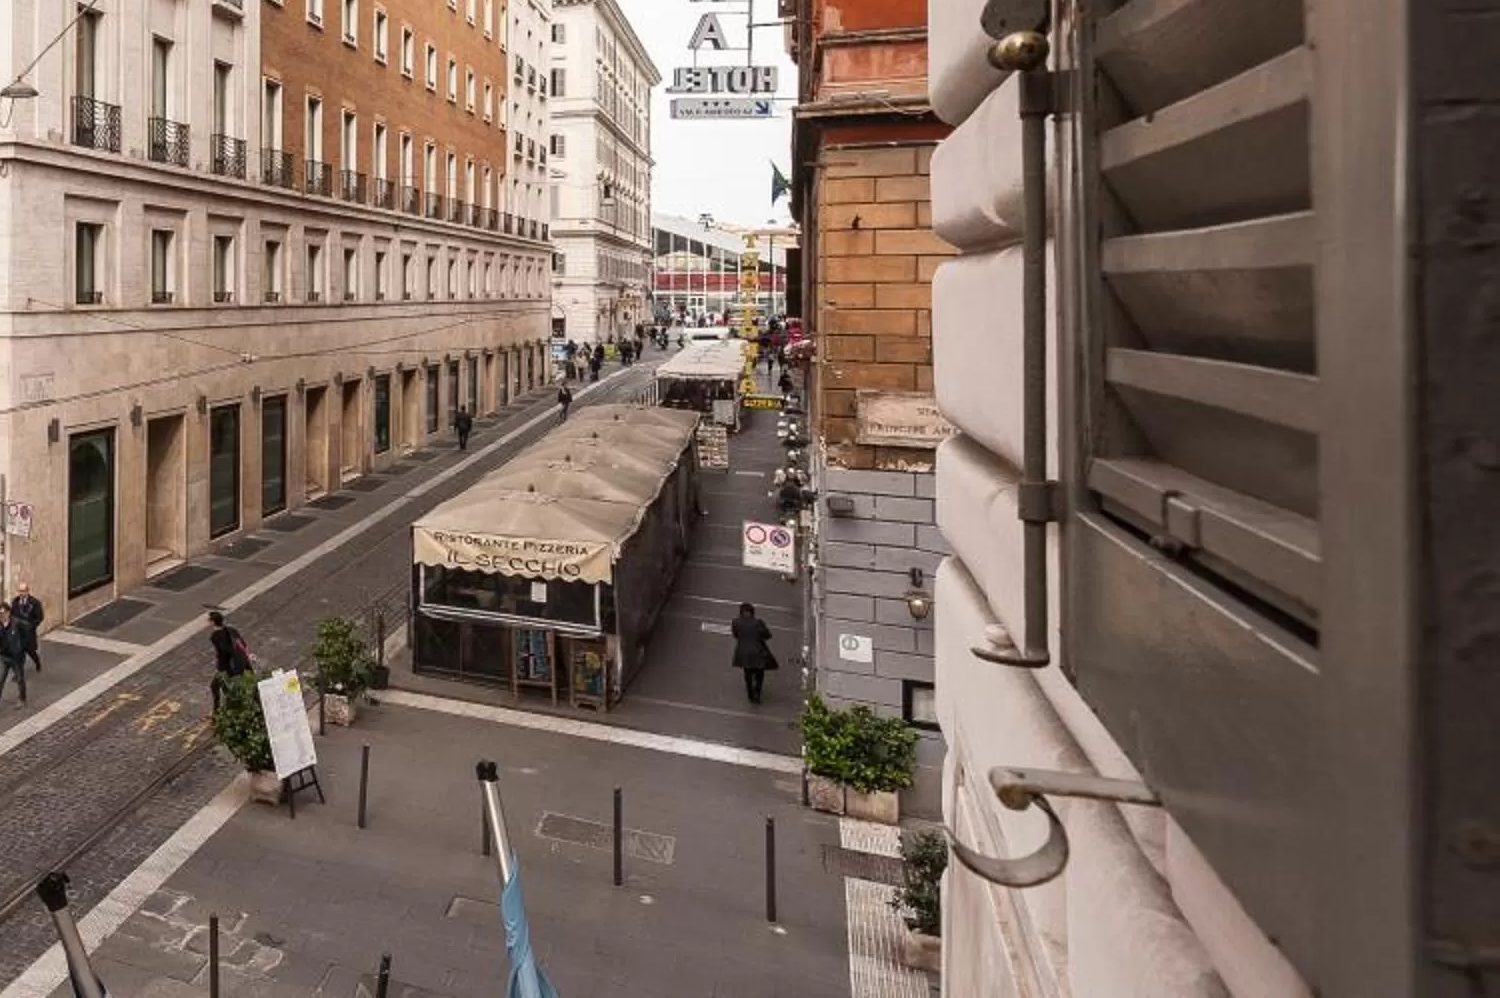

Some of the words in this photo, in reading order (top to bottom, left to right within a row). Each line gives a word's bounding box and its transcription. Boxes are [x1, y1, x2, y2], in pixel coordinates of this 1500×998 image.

[433, 531, 519, 551] RISTORANTE
[523, 542, 589, 555] PIZZERIA
[447, 549, 470, 565] IL
[475, 553, 581, 577] SECCHIO
